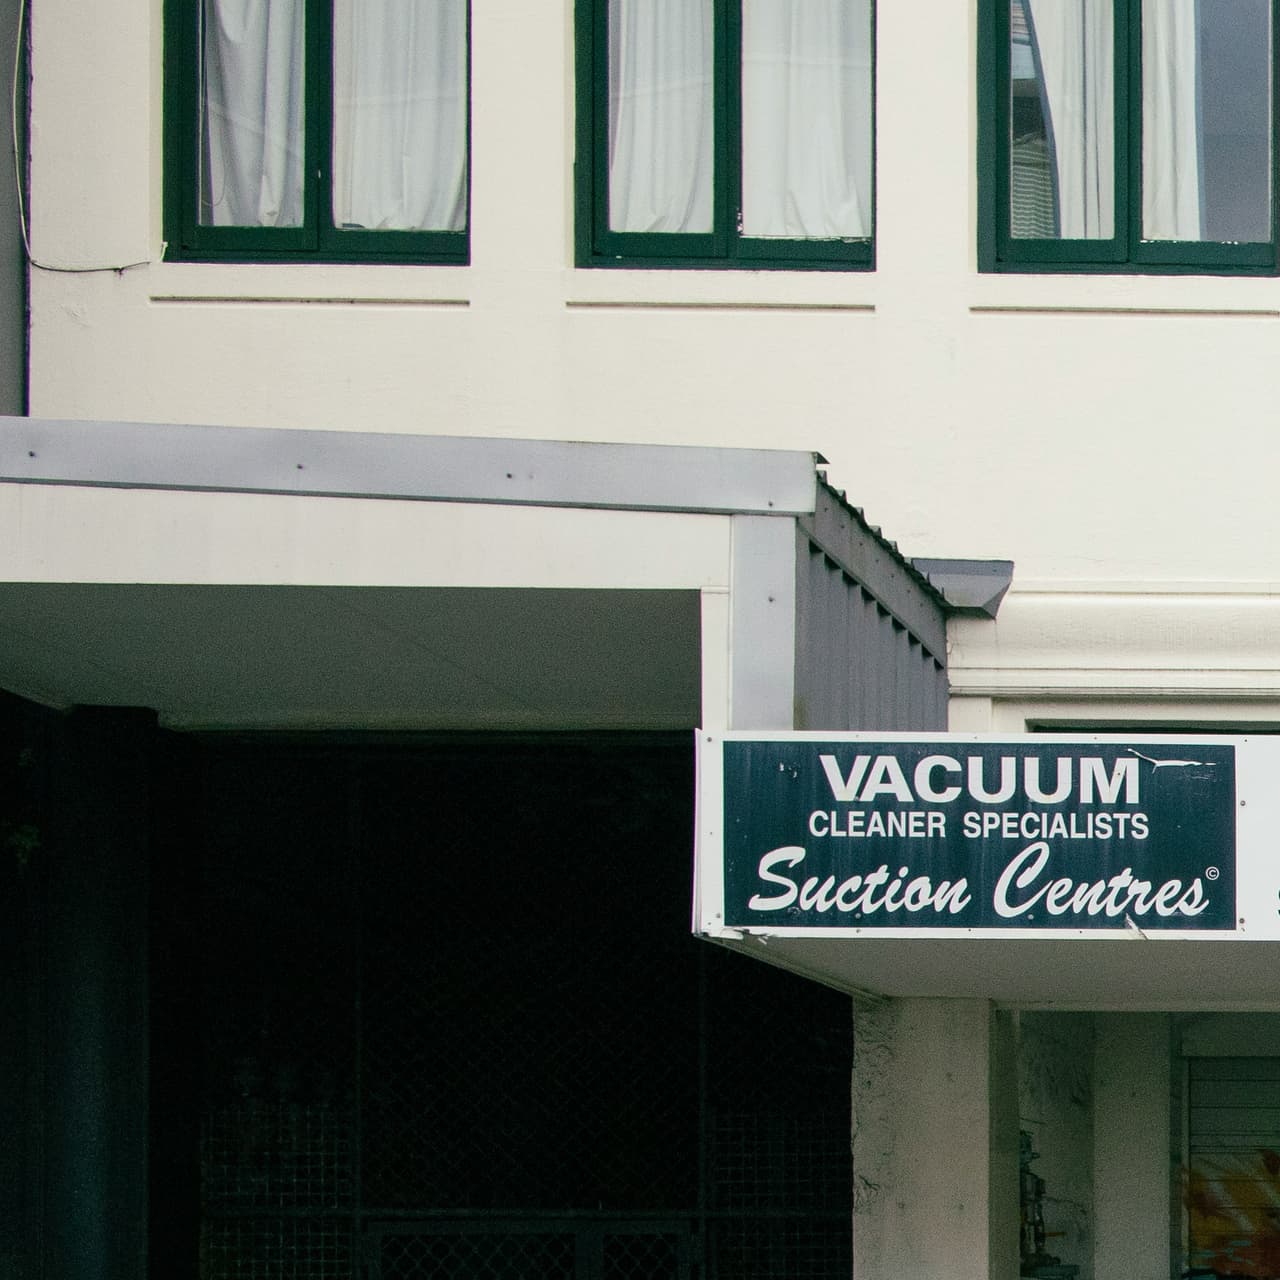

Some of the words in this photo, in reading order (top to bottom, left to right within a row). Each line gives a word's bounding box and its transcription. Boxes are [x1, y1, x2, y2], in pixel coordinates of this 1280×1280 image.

[819, 755, 1140, 804] VACUUM
[808, 811, 946, 839] CLEANER
[963, 811, 1149, 840] SPECIALISTS
[749, 846, 971, 915] Suction
